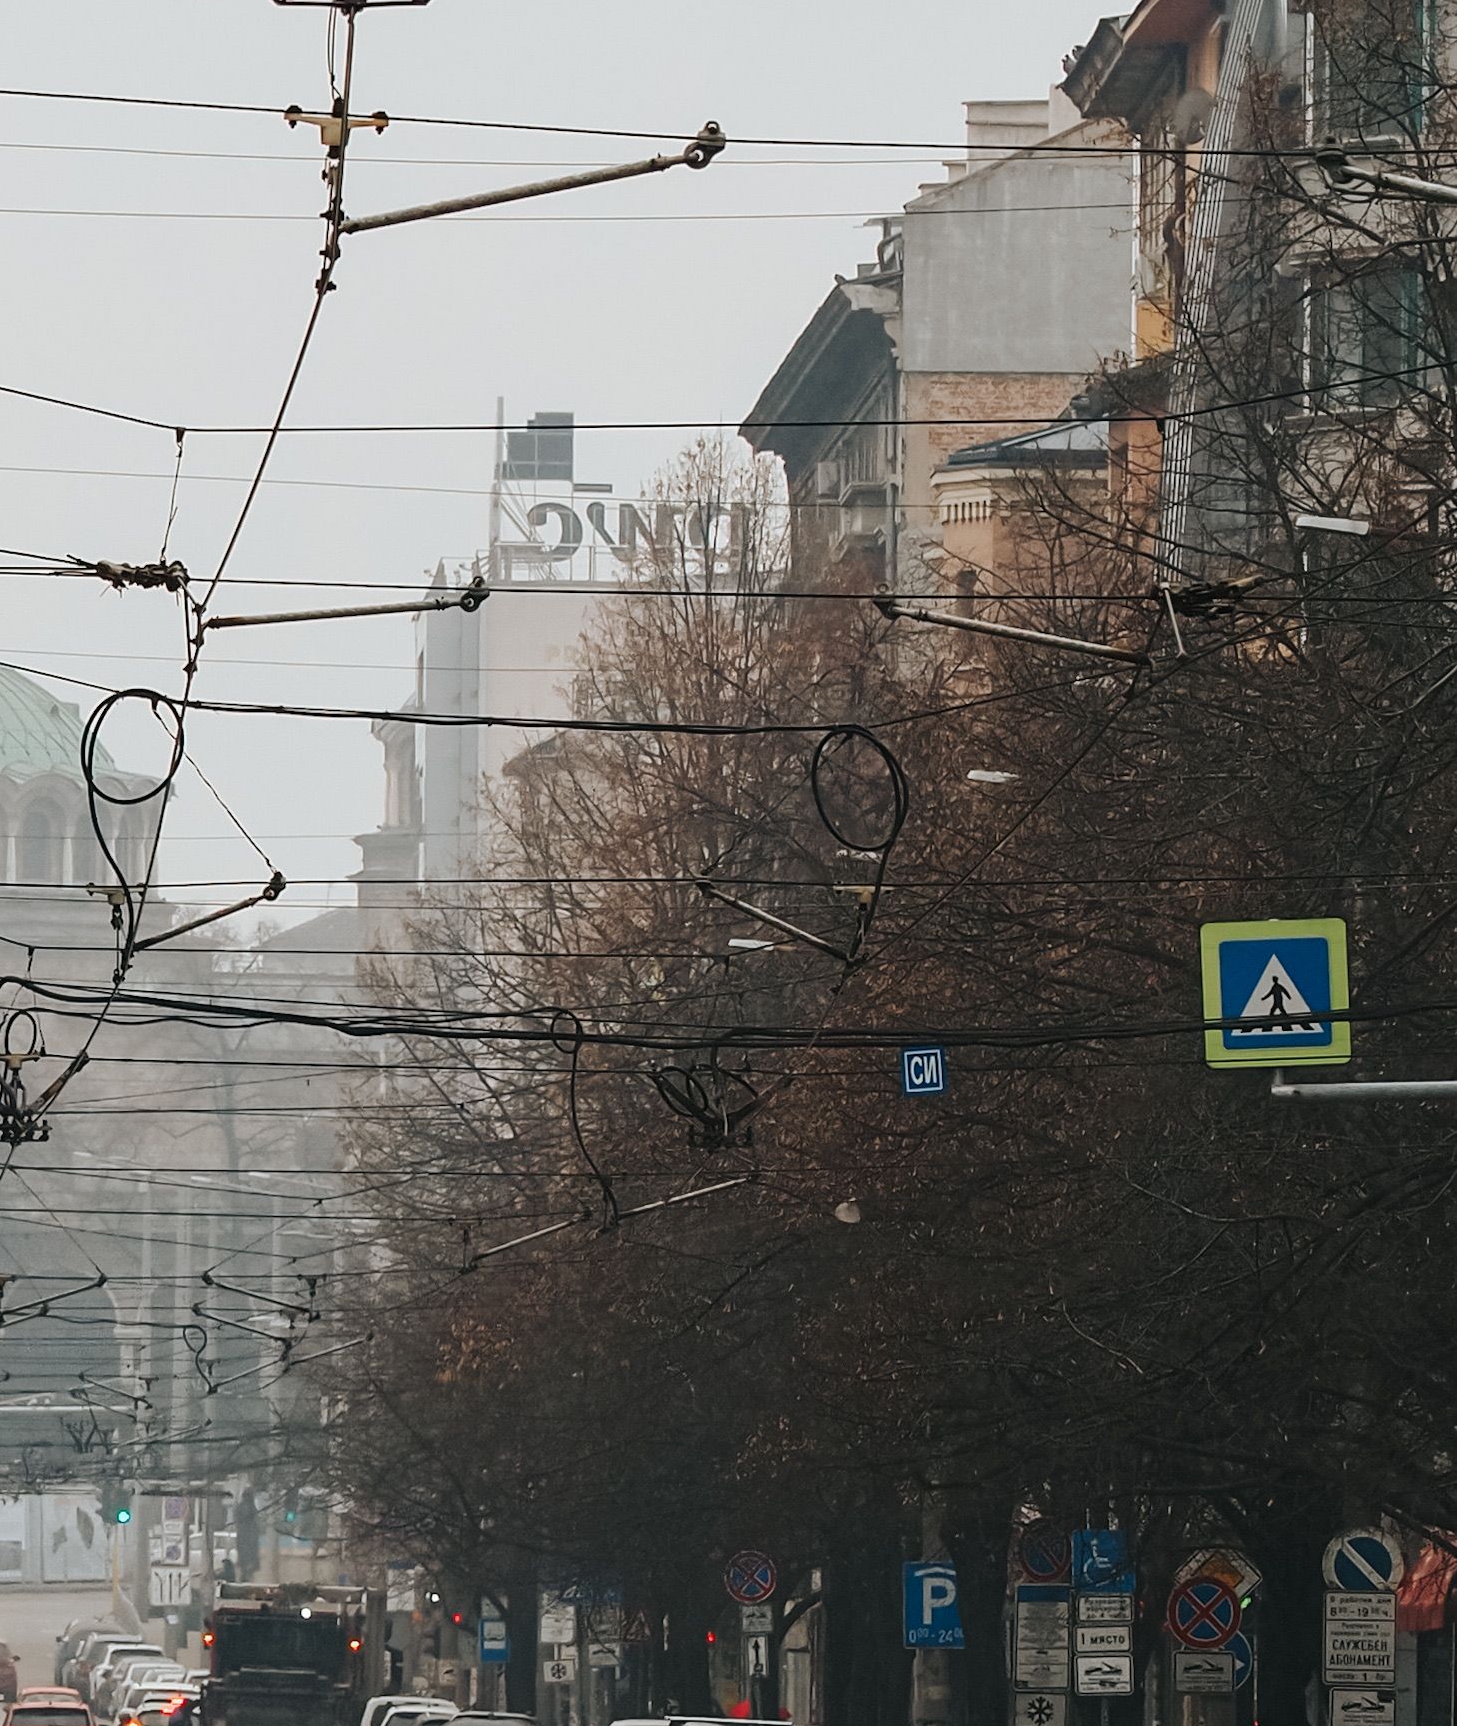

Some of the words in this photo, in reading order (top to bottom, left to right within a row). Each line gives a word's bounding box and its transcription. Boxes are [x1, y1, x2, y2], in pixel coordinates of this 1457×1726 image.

[910, 1056, 937, 1085] СИ
[923, 1578, 956, 1625] P
[1332, 1639, 1388, 1651] СЛУЖЕБЕН
[1329, 1654, 1391, 1666] АБОНАМЕНТ
